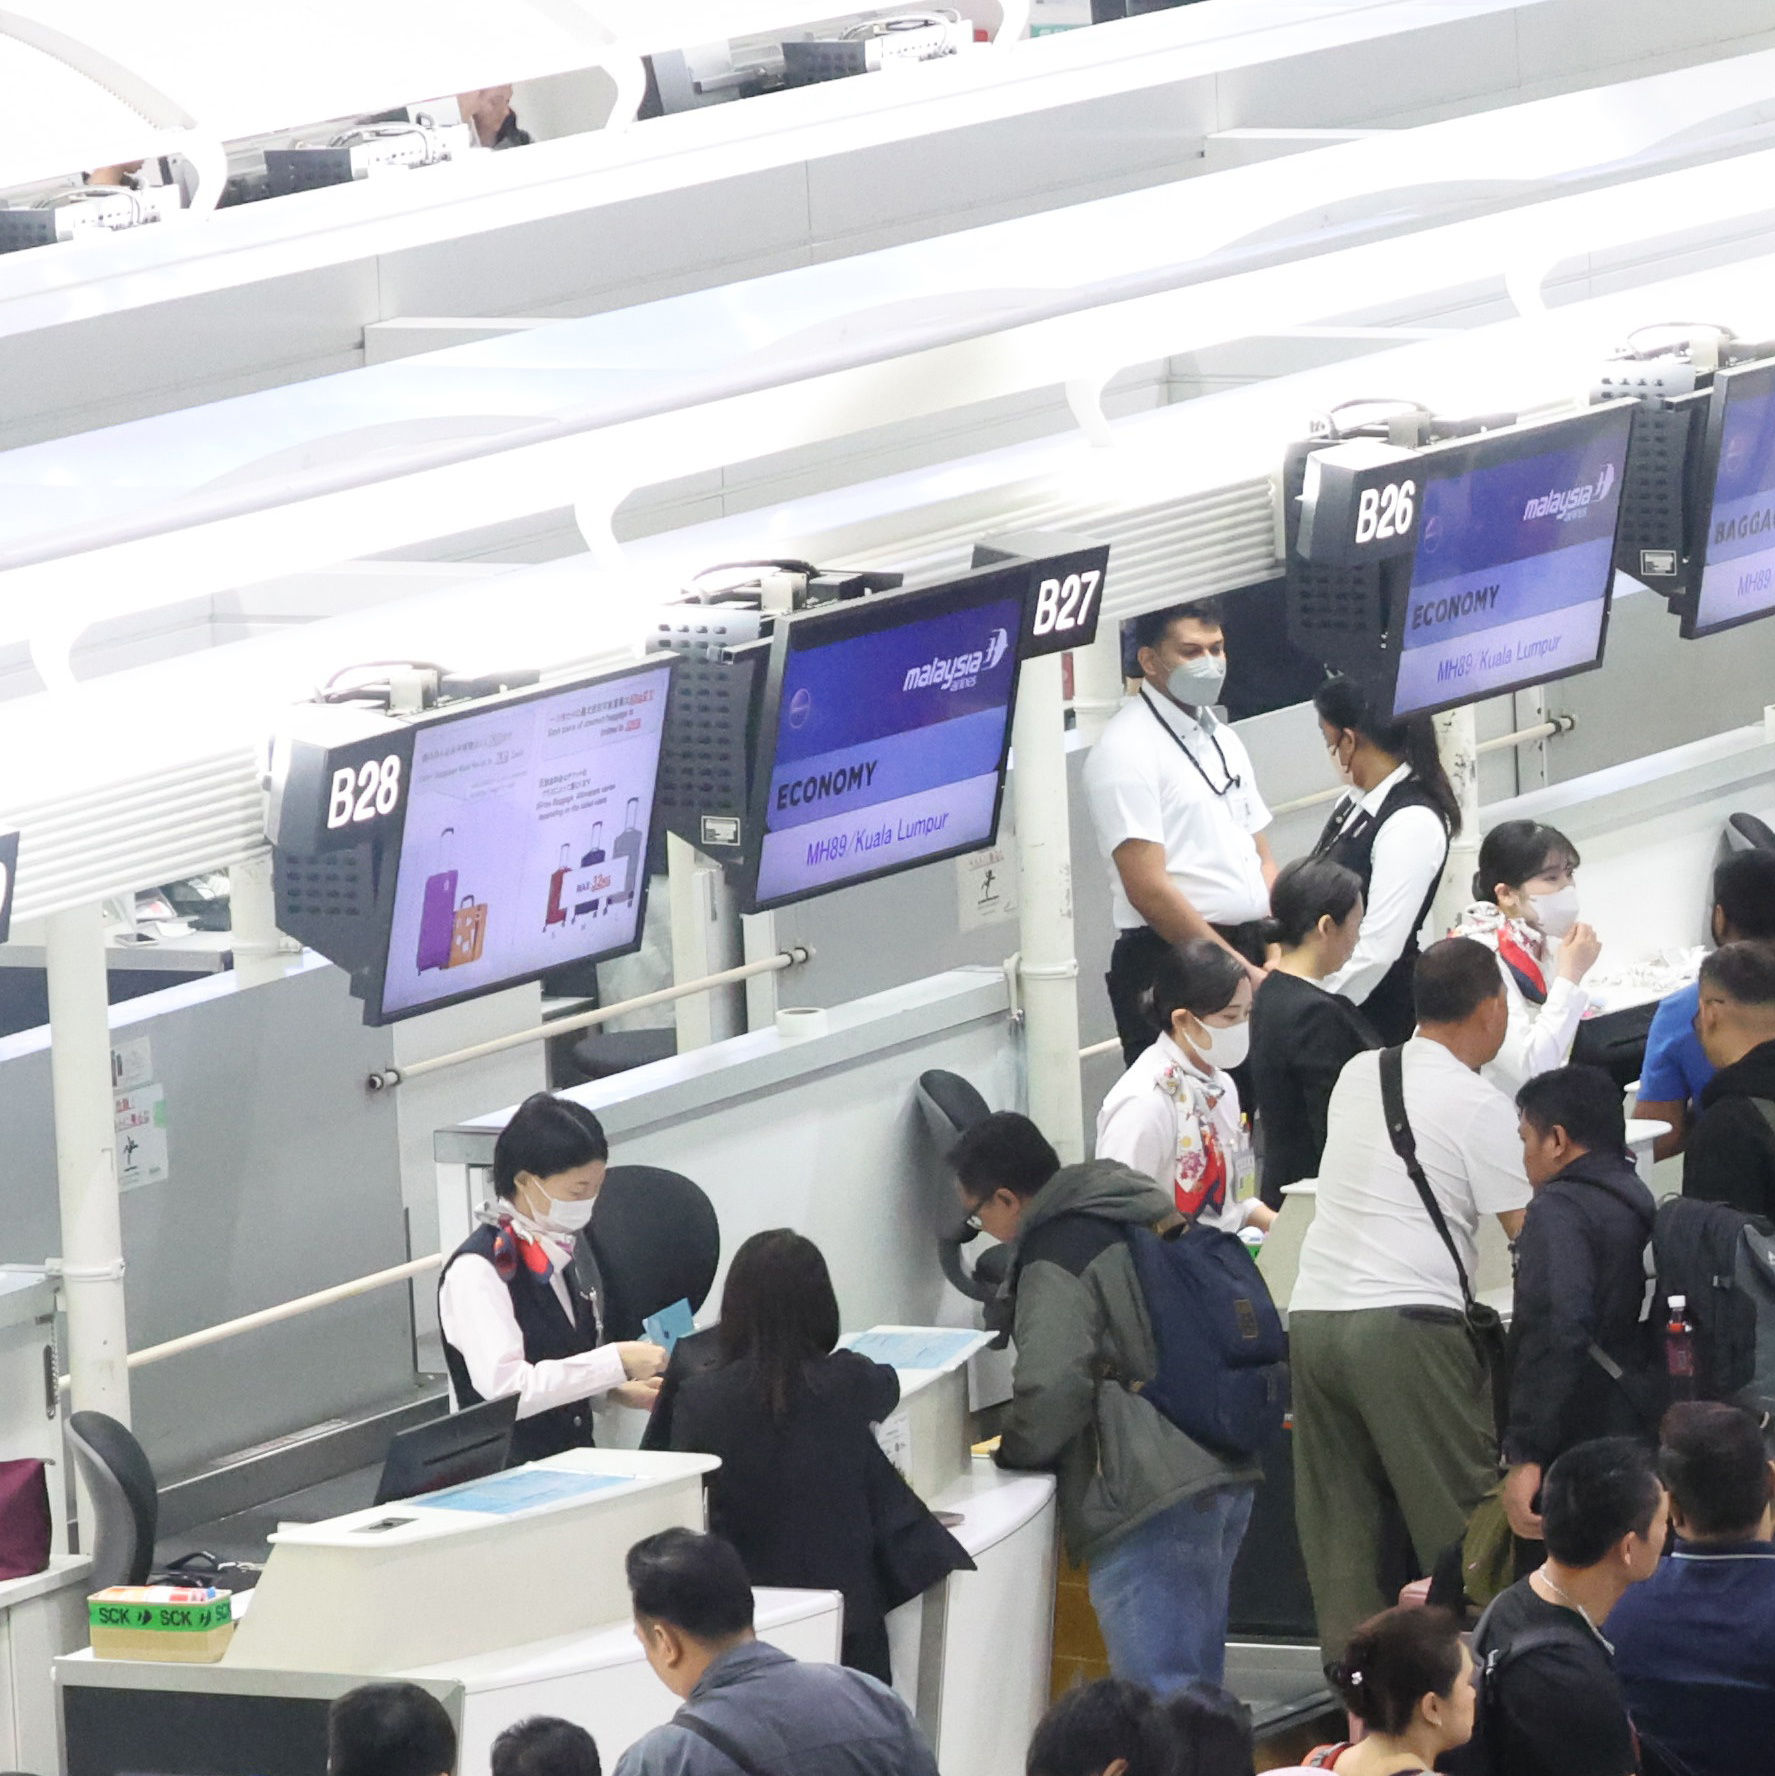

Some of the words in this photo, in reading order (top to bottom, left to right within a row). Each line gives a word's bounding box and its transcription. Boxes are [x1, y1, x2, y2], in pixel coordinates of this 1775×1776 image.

[1356, 480, 1416, 544] B26
[1523, 484, 1593, 521] malaysia
[1033, 570, 1101, 637] B27
[1411, 584, 1500, 629] ECONOMY
[1515, 636, 1562, 661] Lumpur
[903, 650, 982, 691] malaysia
[327, 754, 401, 828] B28
[777, 760, 878, 811] ECONOMY
[897, 811, 950, 843] Lumpur
[99, 1608, 130, 1624] SCK
[161, 1609, 191, 1626] SCK
